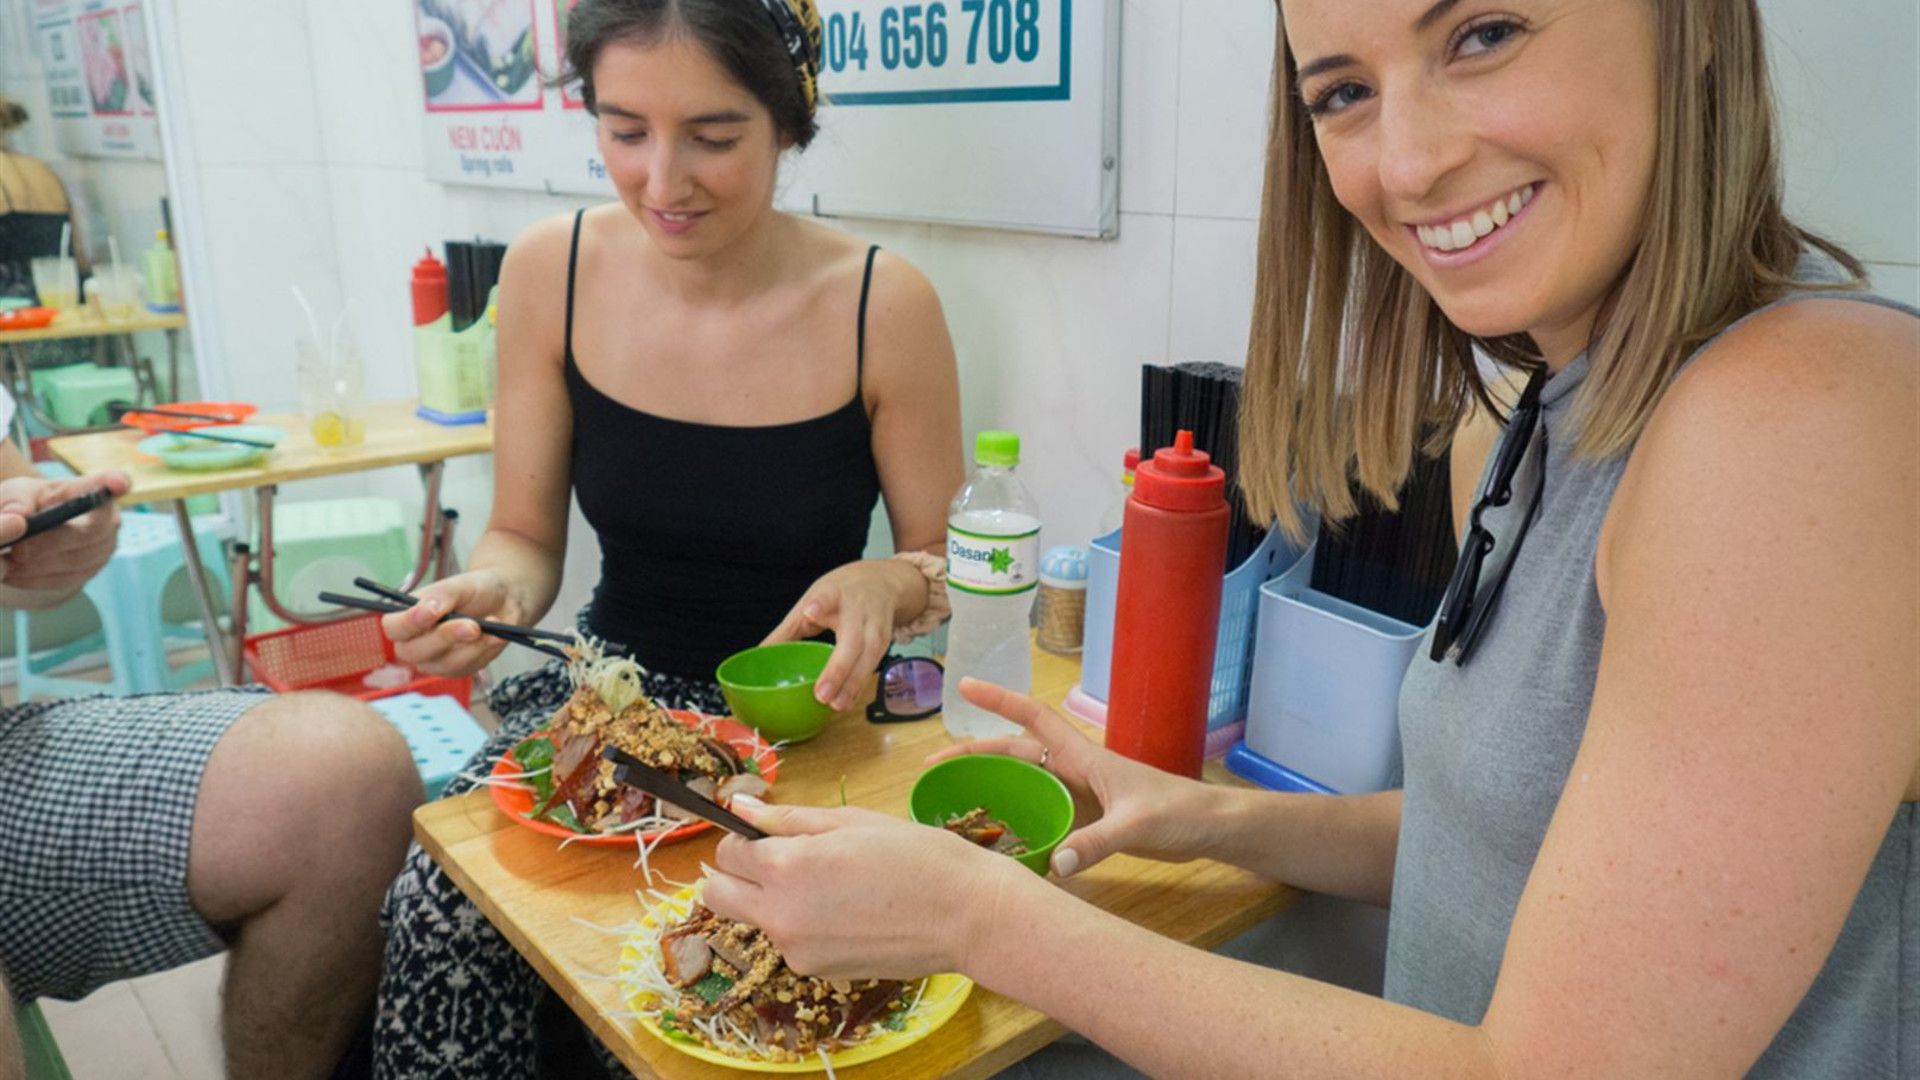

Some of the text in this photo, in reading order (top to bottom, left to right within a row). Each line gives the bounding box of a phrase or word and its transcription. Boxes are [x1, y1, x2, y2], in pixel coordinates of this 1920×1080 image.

[880, 2, 948, 69] 656
[961, 0, 1039, 65] 708
[448, 126, 477, 151] NEM
